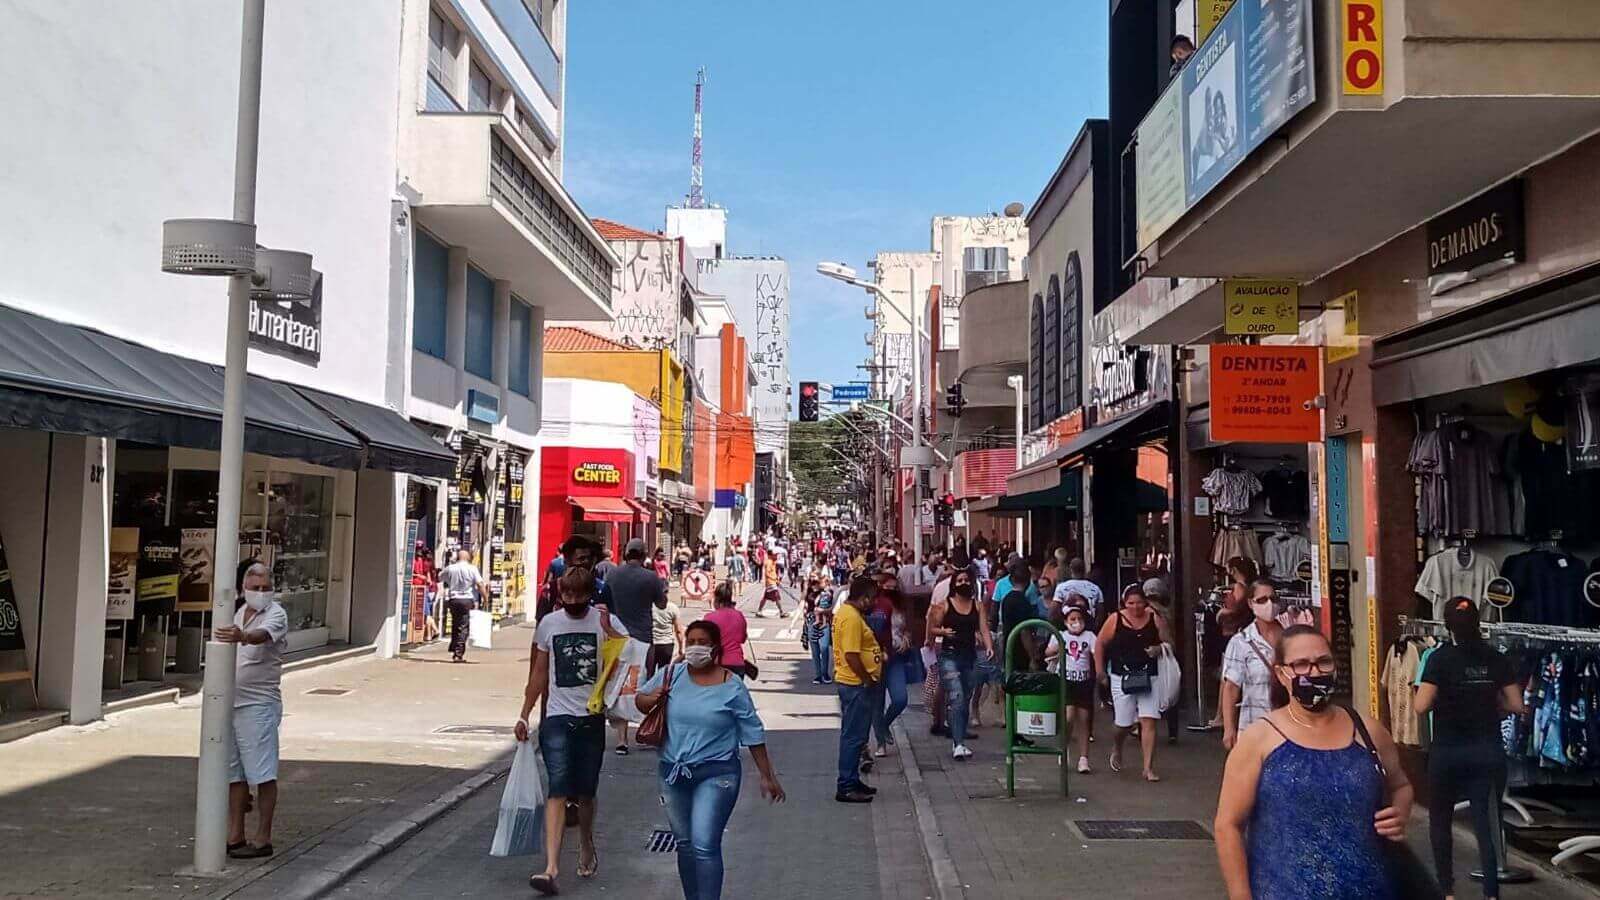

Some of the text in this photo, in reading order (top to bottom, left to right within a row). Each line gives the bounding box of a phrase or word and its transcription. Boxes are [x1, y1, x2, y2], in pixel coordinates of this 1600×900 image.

[1196, 29, 1228, 84] DENTISTA
[1431, 212, 1498, 269] DEMANOS
[1252, 306, 1266, 315] DE
[1247, 323, 1276, 333] OURO
[1221, 356, 1308, 372] DENTISTA
[1253, 378, 1287, 387] ANDAR
[583, 462, 598, 470] FAST
[574, 467, 620, 484] CENTER
